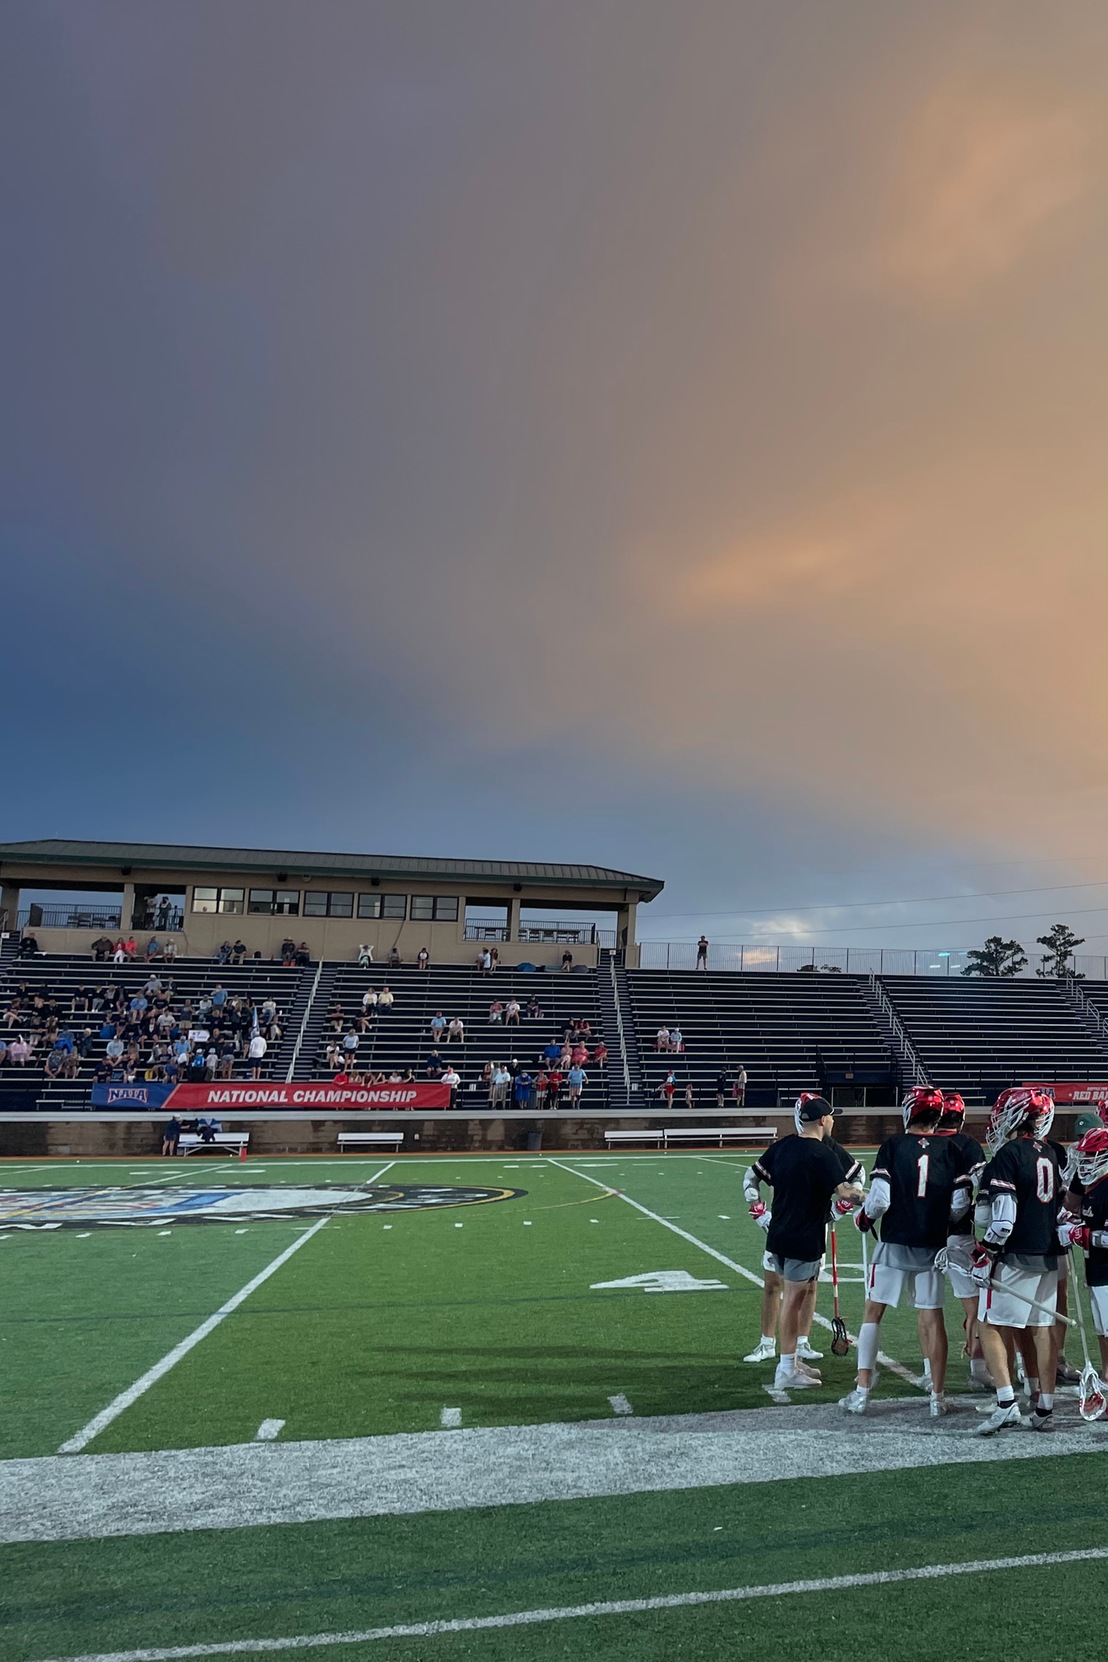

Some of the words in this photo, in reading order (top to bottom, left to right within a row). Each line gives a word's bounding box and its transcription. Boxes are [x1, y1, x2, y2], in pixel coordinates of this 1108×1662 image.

[108, 1088, 147, 1103] NAIA
[207, 1090, 289, 1103] NATIONAL
[292, 1090, 417, 1103] CHAMPIONSHIP
[1073, 1091, 1090, 1100] RED
[917, 1153, 930, 1198] 1
[1036, 1156, 1055, 1204] 0
